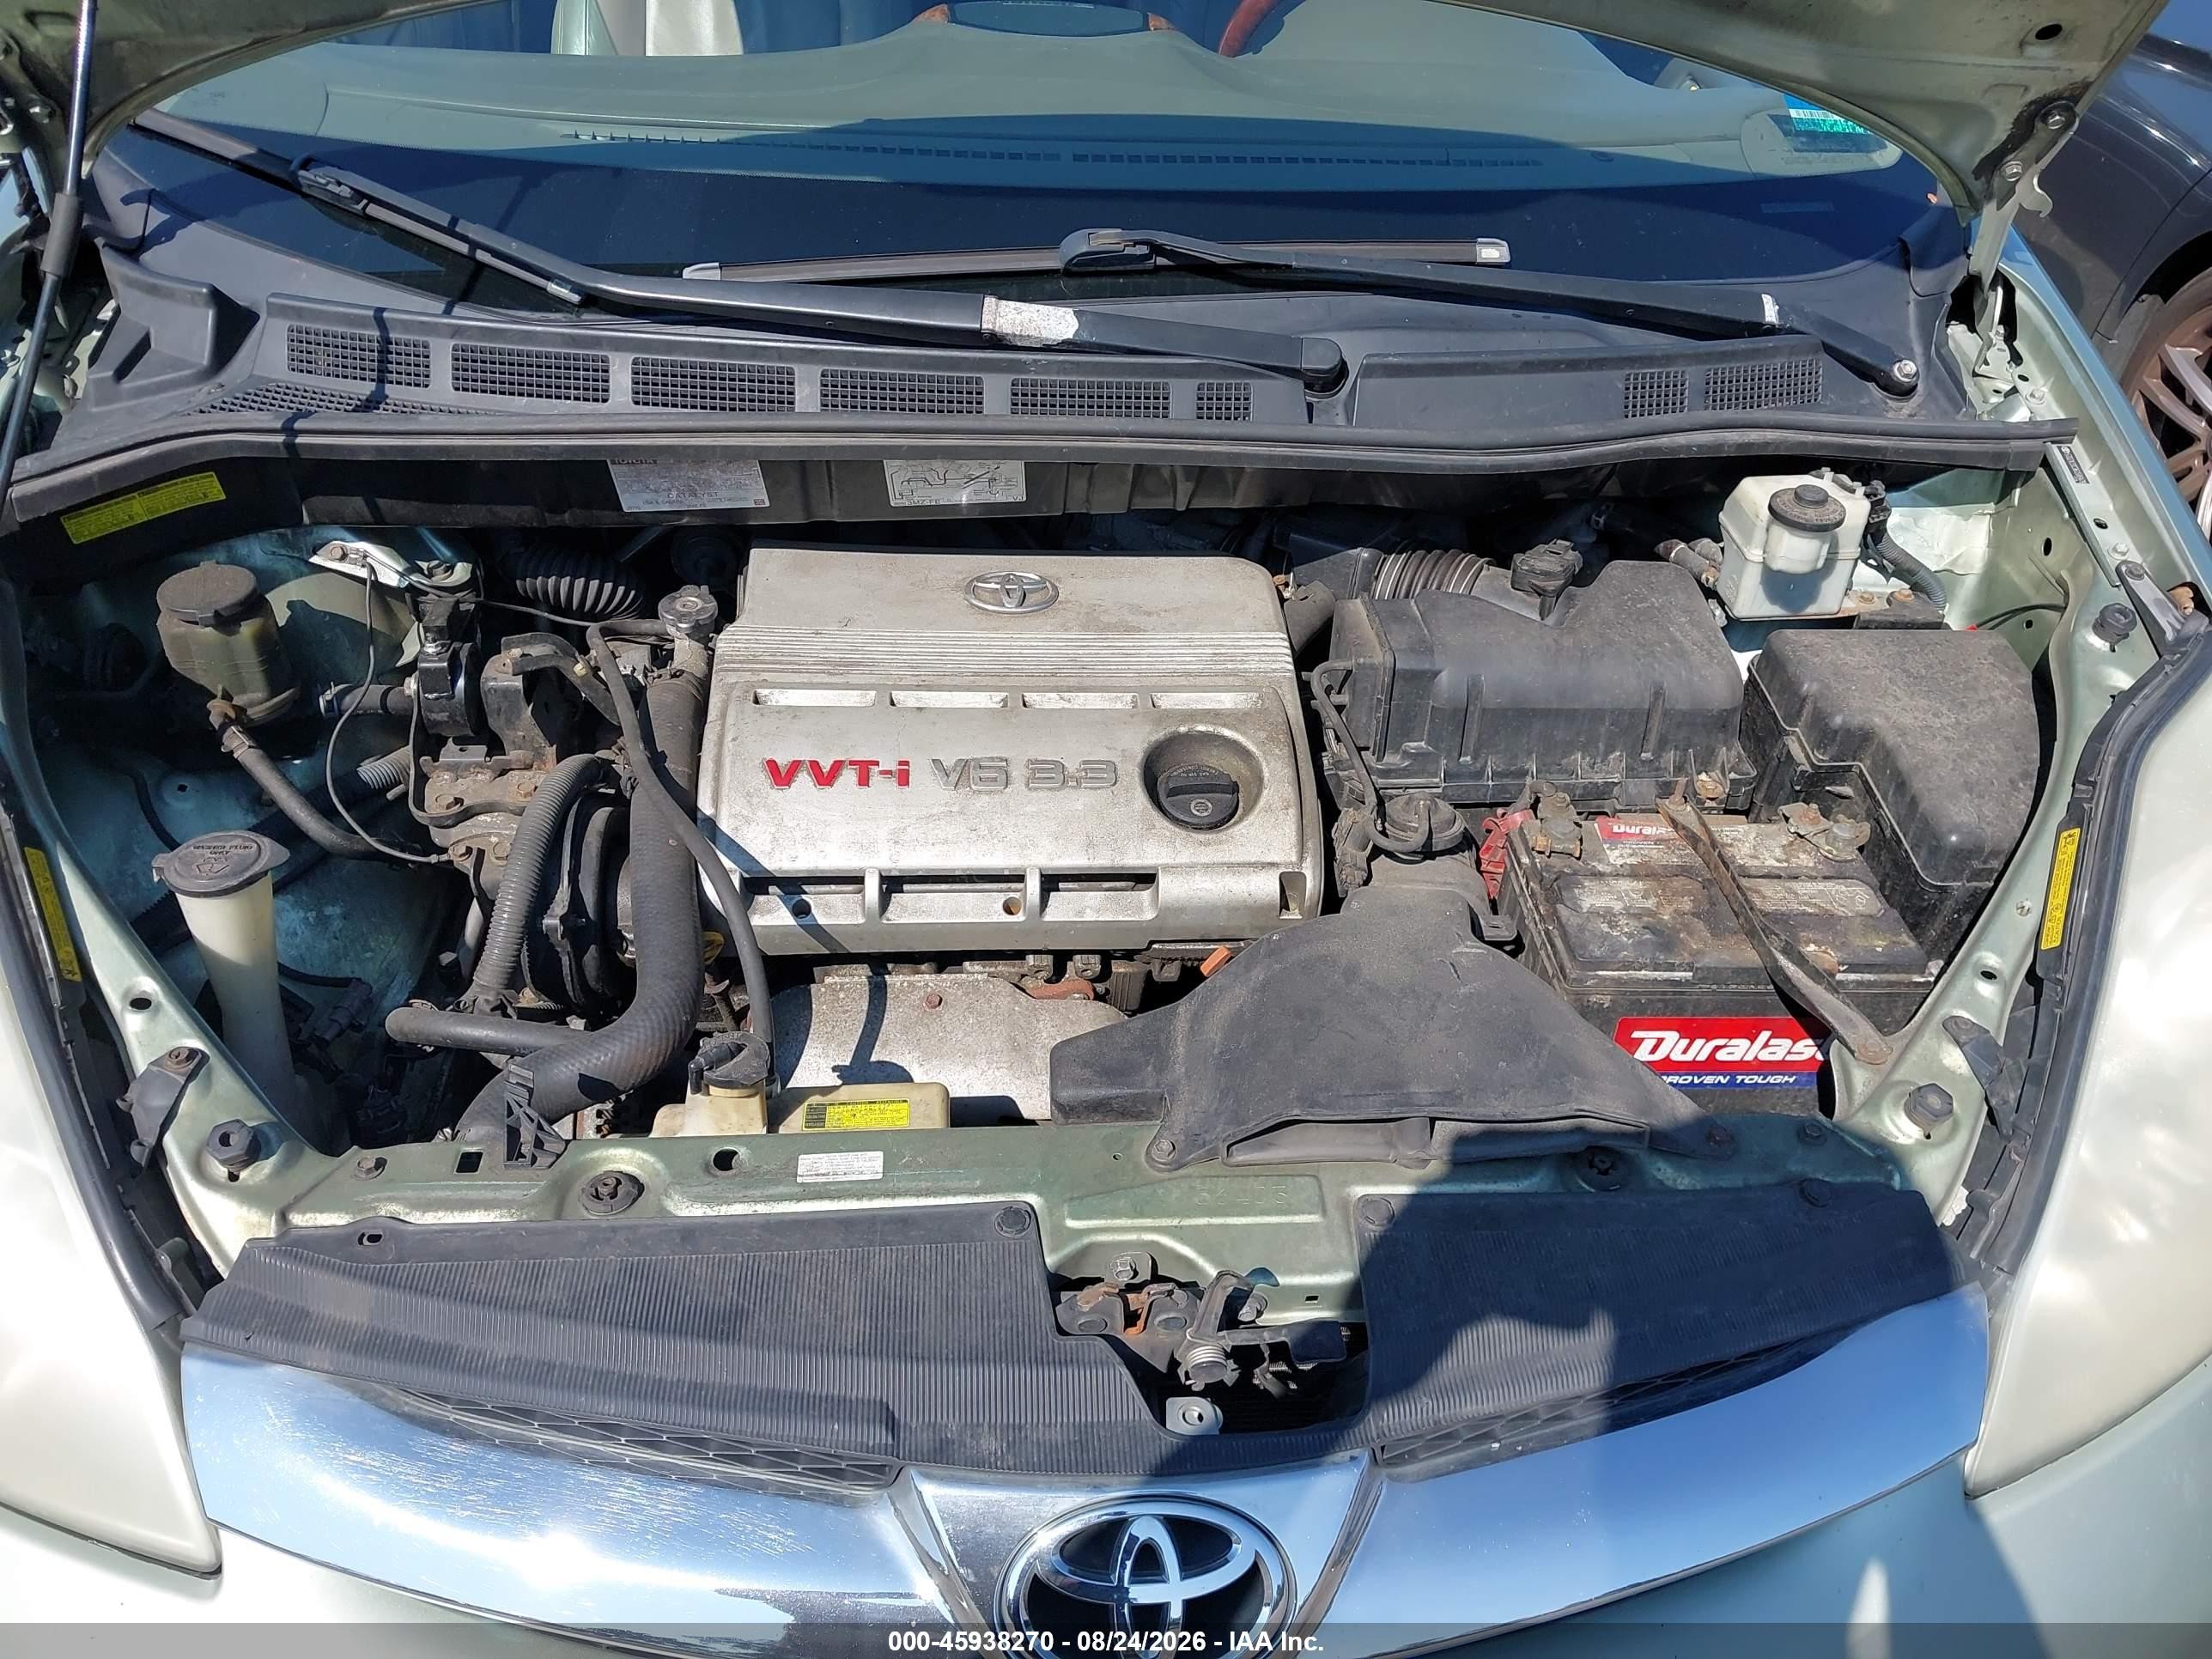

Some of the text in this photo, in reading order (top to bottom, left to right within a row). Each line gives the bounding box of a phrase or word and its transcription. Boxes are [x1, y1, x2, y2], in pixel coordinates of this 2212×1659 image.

[763, 757, 1117, 791] VVT-i V6 3.3
[1630, 1030, 1825, 1062] Duralas
[1735, 1075, 1797, 1085] TOUGH
